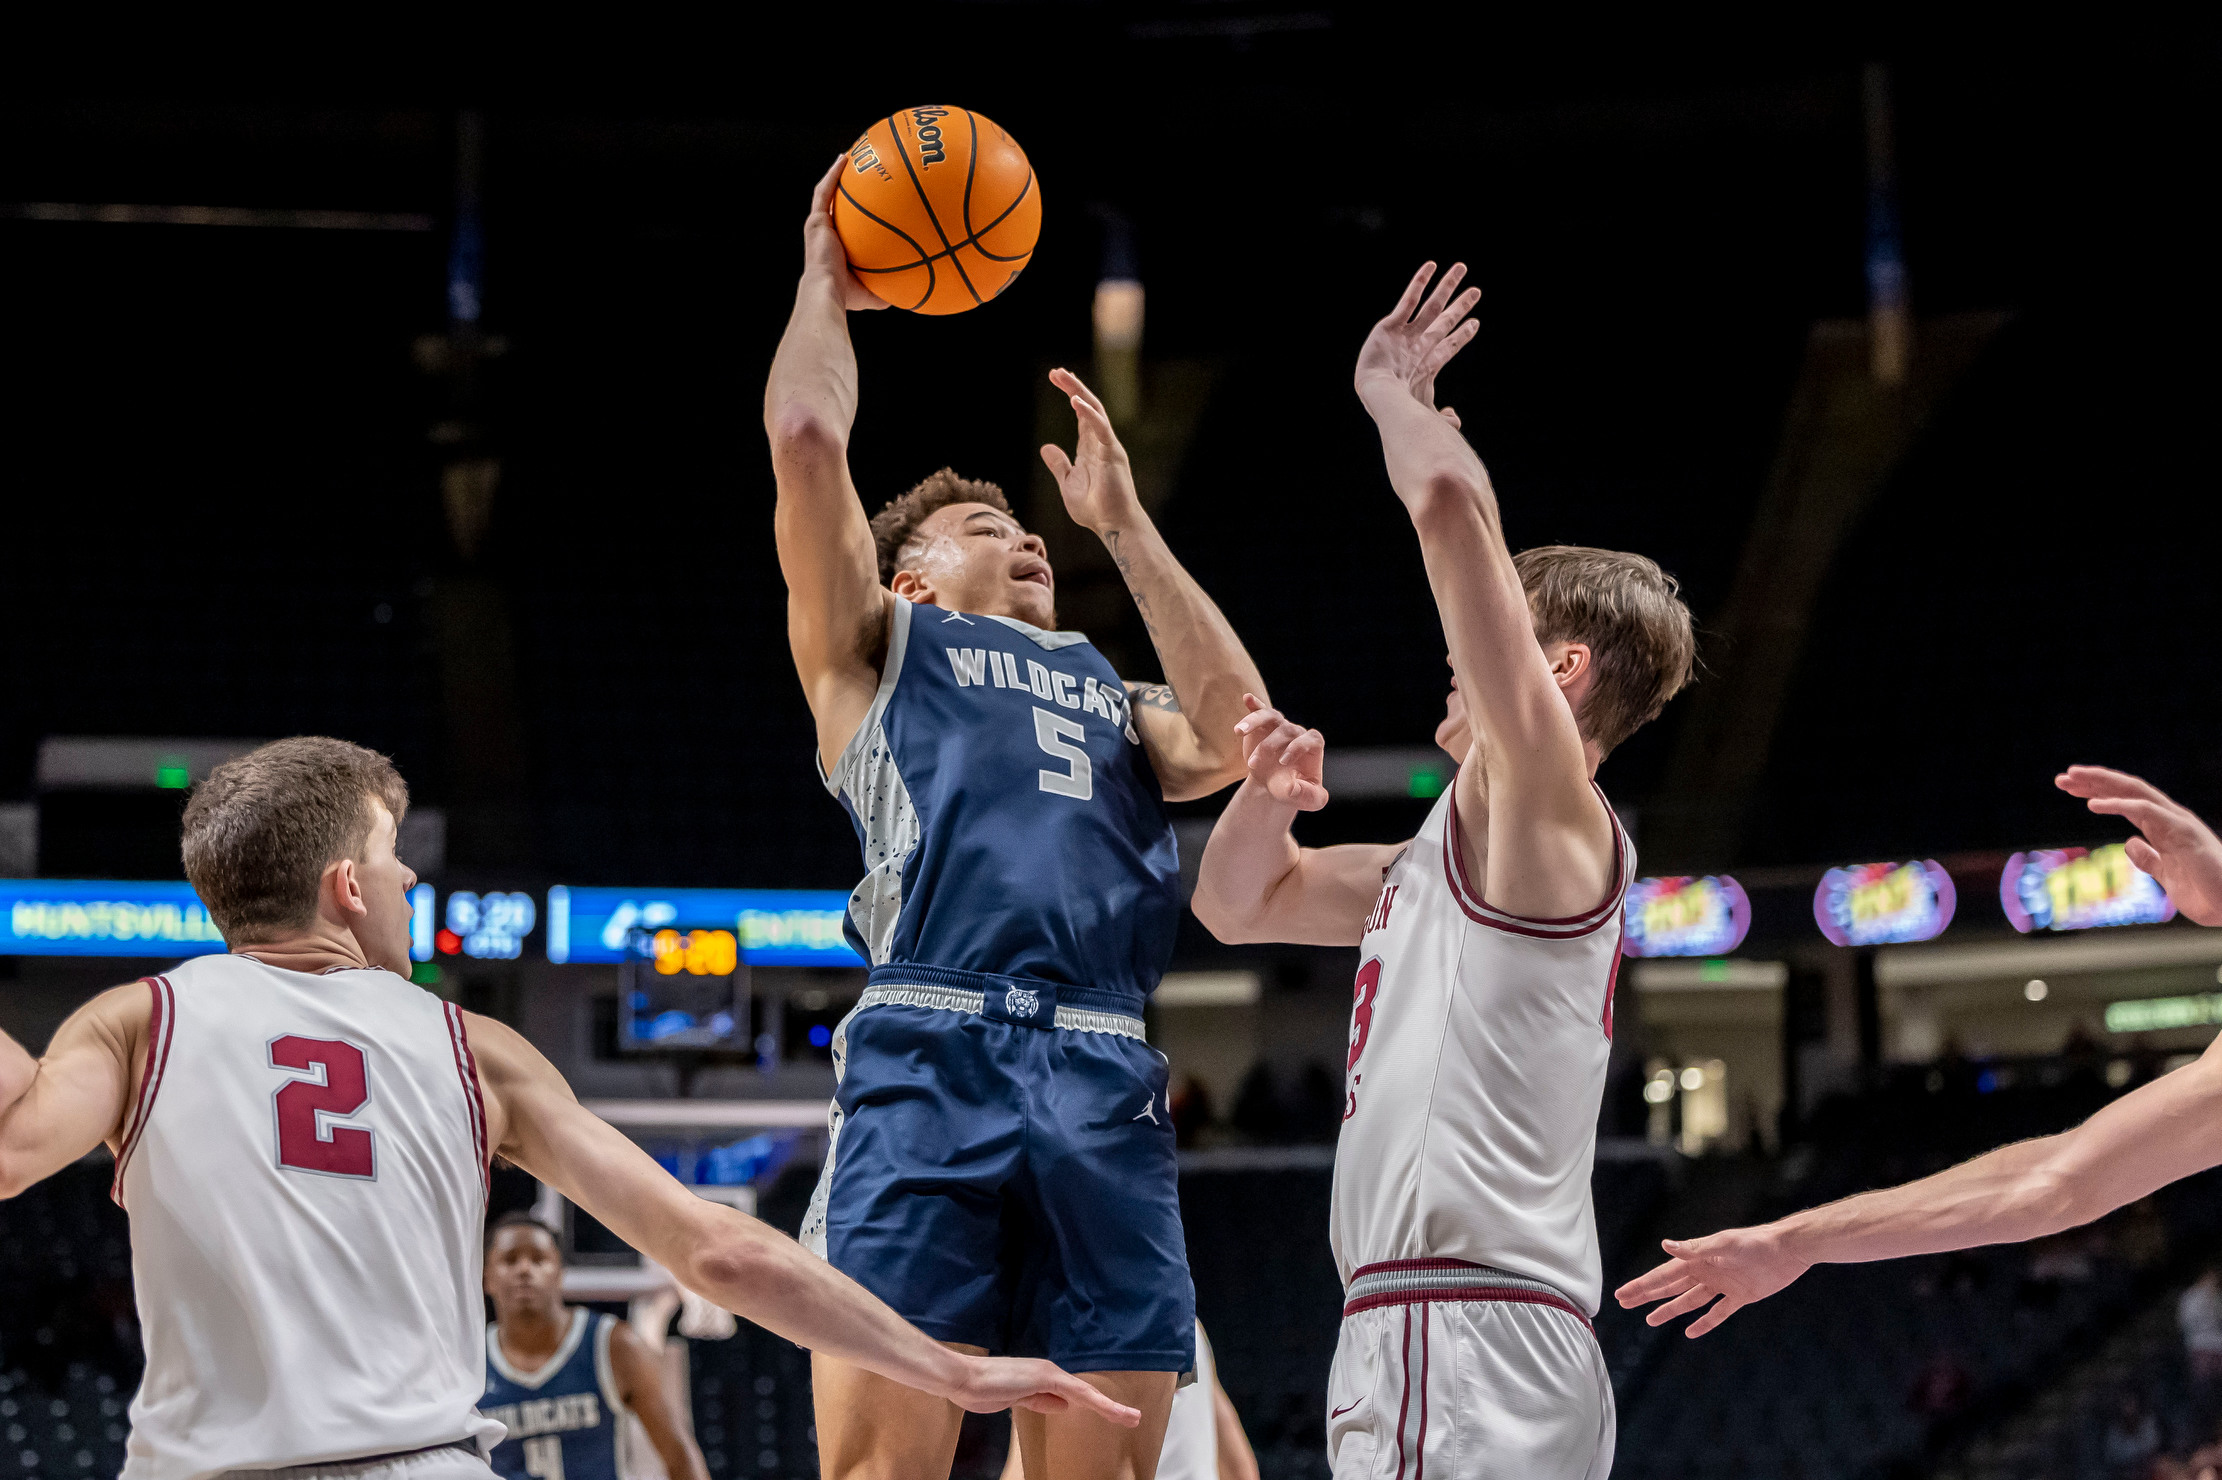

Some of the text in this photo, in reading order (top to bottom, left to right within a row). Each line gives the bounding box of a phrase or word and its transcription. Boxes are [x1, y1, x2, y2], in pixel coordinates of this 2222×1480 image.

[851, 133, 880, 175] VO
[1032, 705, 1093, 801] 5
[265, 1032, 378, 1182] 2
[522, 1433, 567, 1480] 4
